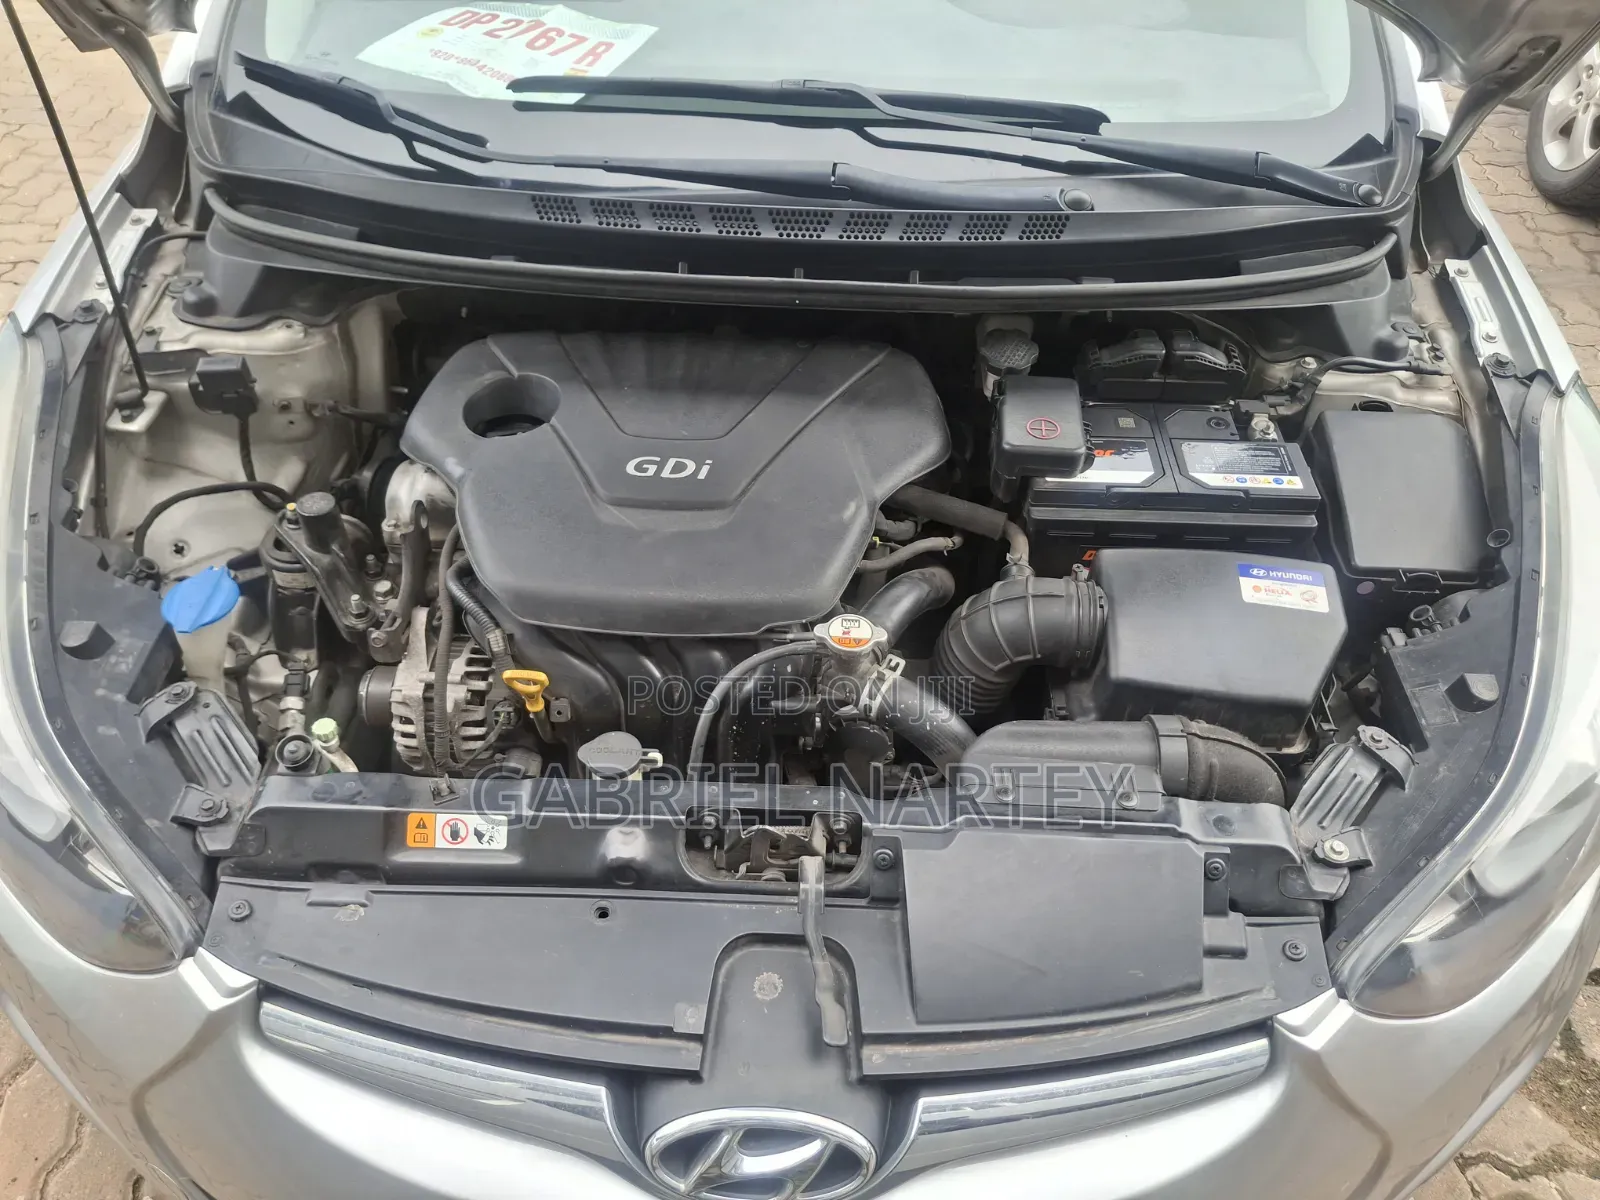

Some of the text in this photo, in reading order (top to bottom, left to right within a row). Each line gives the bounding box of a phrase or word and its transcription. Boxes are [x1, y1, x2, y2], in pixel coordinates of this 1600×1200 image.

[438, 9, 501, 30] DP
[572, 41, 616, 67] R
[625, 456, 713, 480] GDi
[1269, 570, 1313, 582] HYUNDAI
